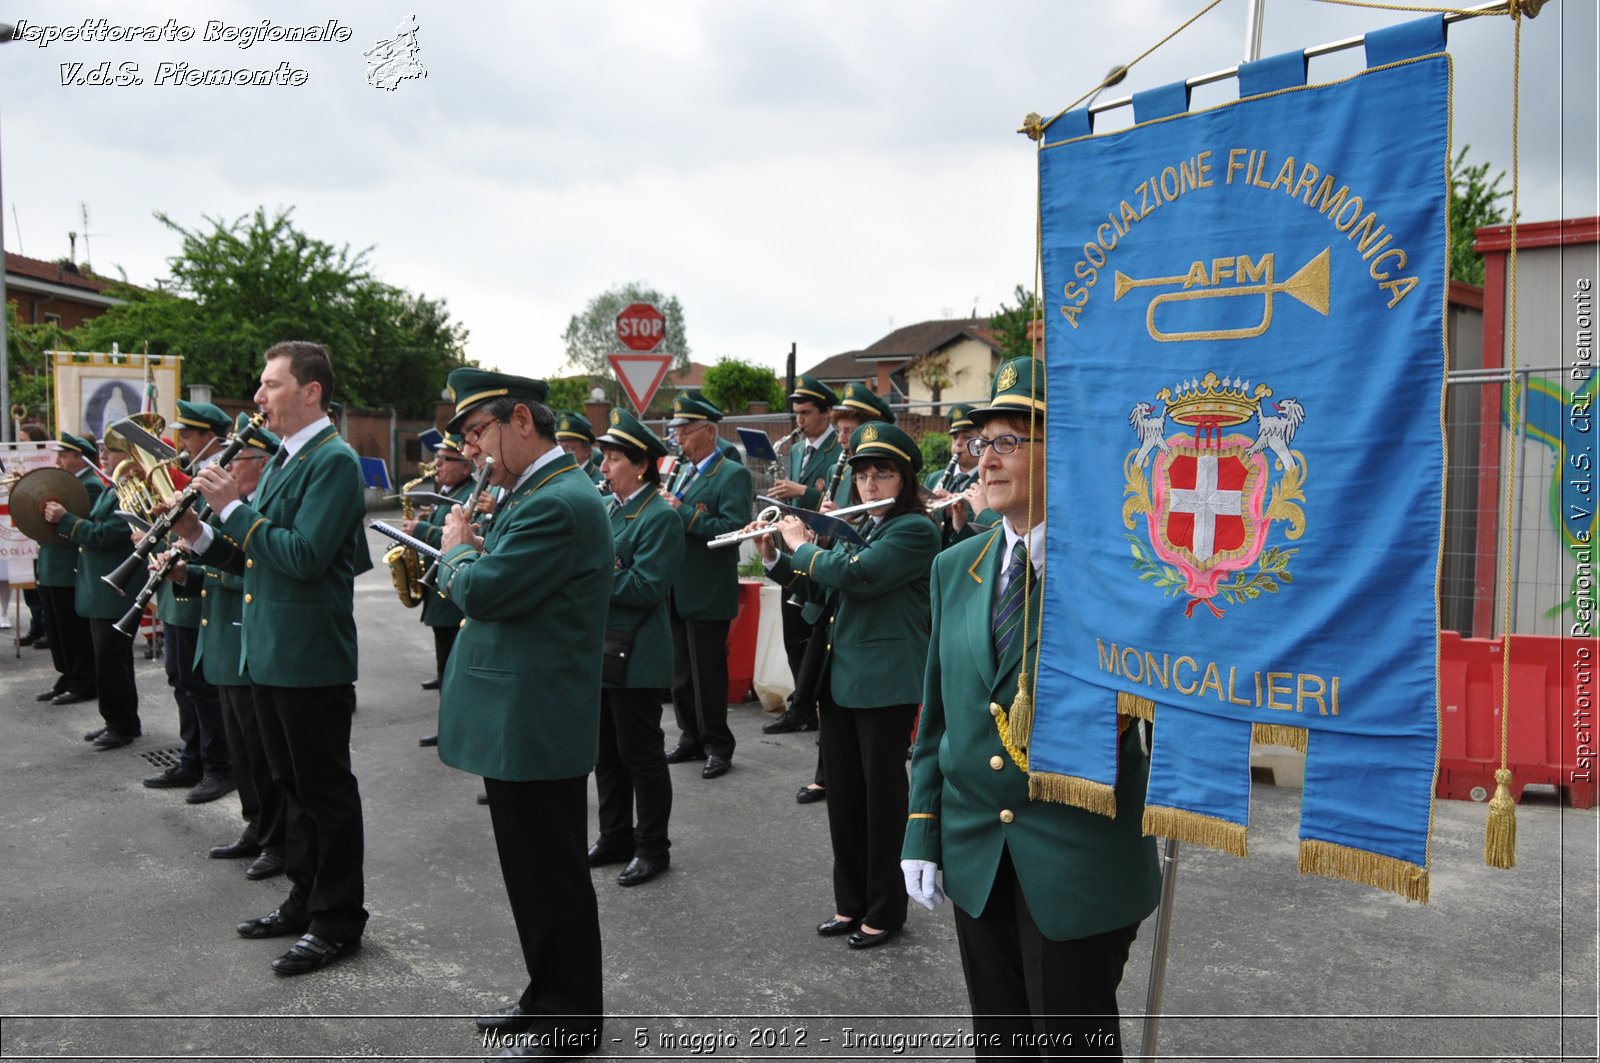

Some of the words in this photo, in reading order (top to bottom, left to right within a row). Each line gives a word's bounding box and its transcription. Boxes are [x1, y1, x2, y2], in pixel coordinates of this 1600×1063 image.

[1060, 150, 1213, 329] ASSOCIAZIONE
[1226, 148, 1420, 309] FILARMONICA
[1182, 253, 1274, 289] AFM
[619, 318, 662, 337] STOP
[1096, 638, 1340, 716] MONCALIERI
